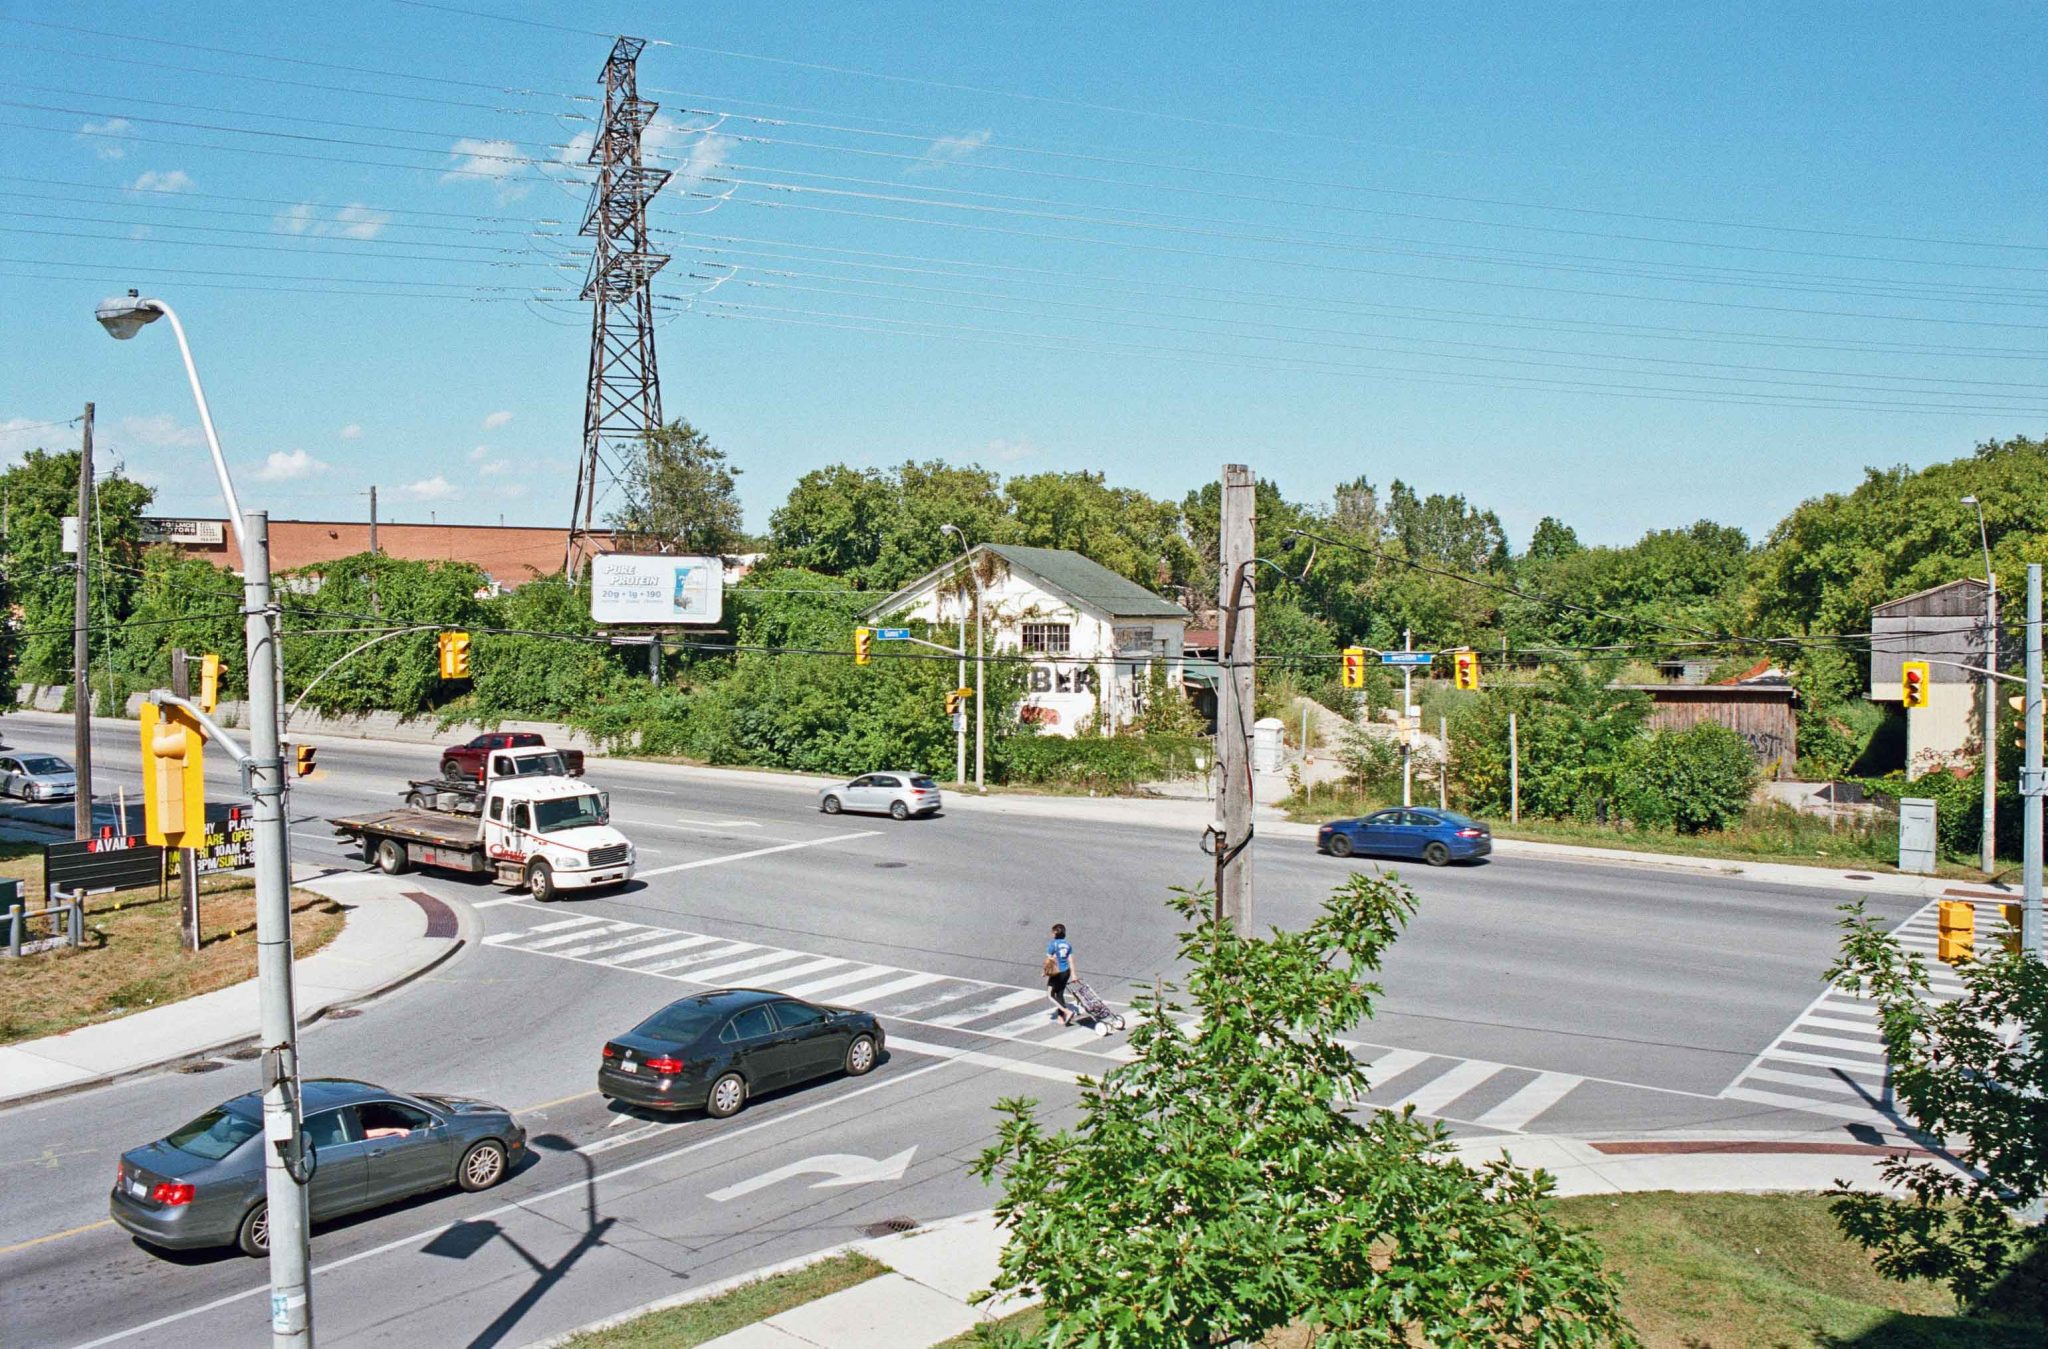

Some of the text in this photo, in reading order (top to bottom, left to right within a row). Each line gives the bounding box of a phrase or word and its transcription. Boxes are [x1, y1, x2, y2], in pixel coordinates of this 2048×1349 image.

[604, 564, 636, 575] PURE
[609, 575, 659, 586] PROTEIN
[601, 590, 620, 599] 20g
[647, 590, 662, 598] 190
[95, 838, 128, 852] AVAIL
[206, 833, 224, 848] ARE
[214, 842, 240, 857] 10AM
